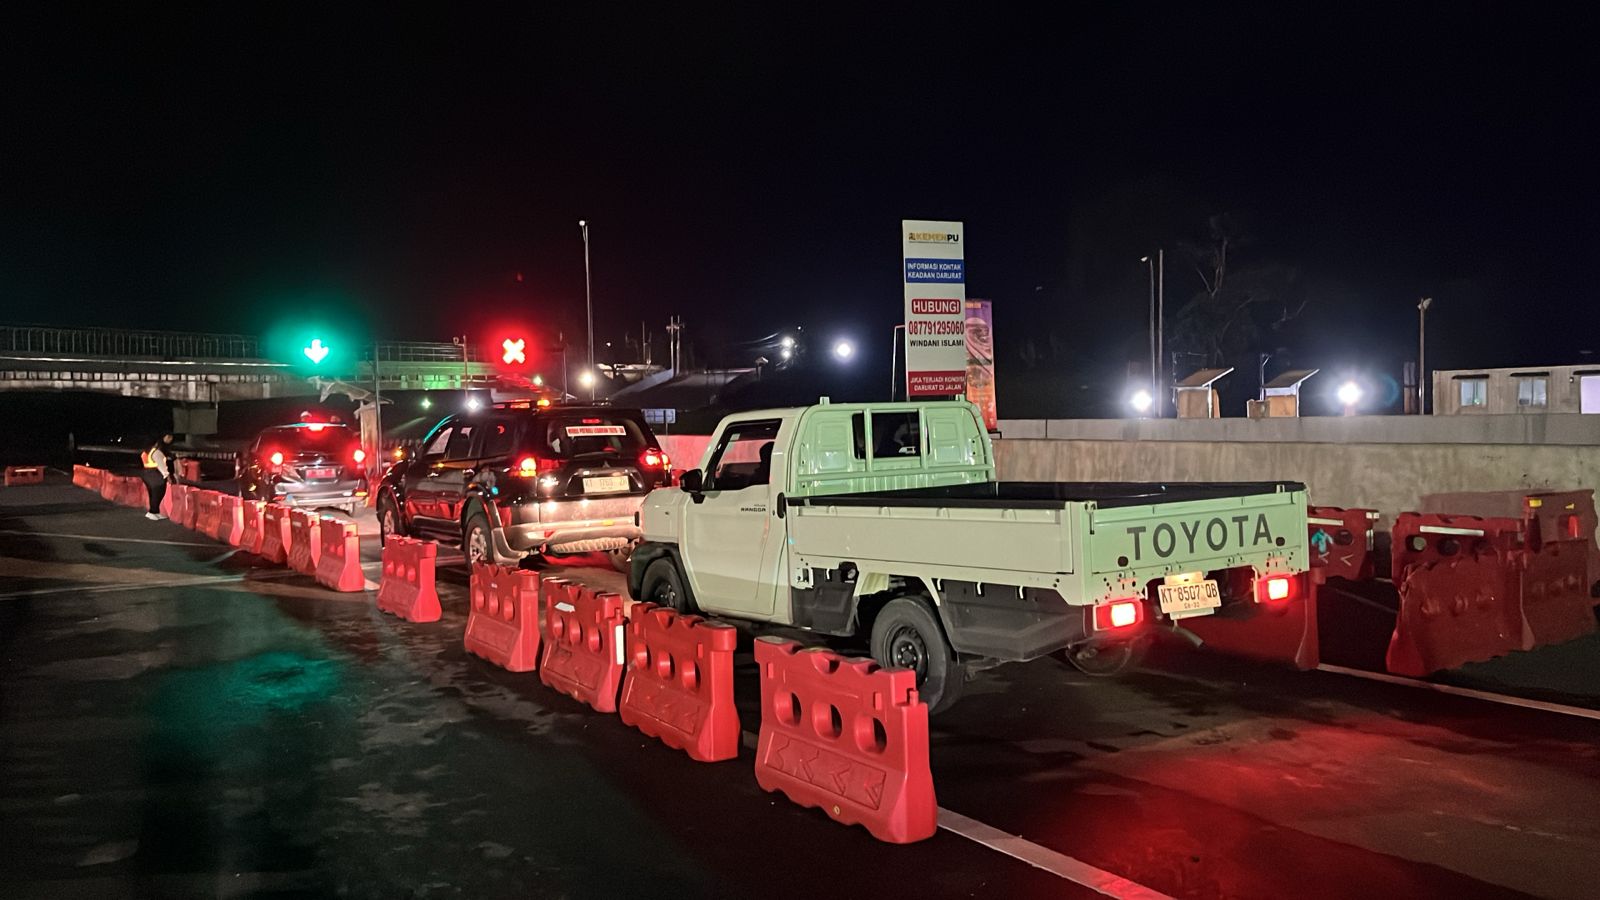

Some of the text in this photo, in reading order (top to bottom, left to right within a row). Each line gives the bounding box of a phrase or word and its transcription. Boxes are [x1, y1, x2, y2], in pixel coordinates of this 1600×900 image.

[913, 301, 960, 313] HUBUNGI
[908, 321, 965, 335] 087791295060
[910, 376, 923, 384] JIKA
[1126, 513, 1273, 561] TOYOTA
[1160, 588, 1173, 604] KT
[1205, 583, 1218, 598] QB
